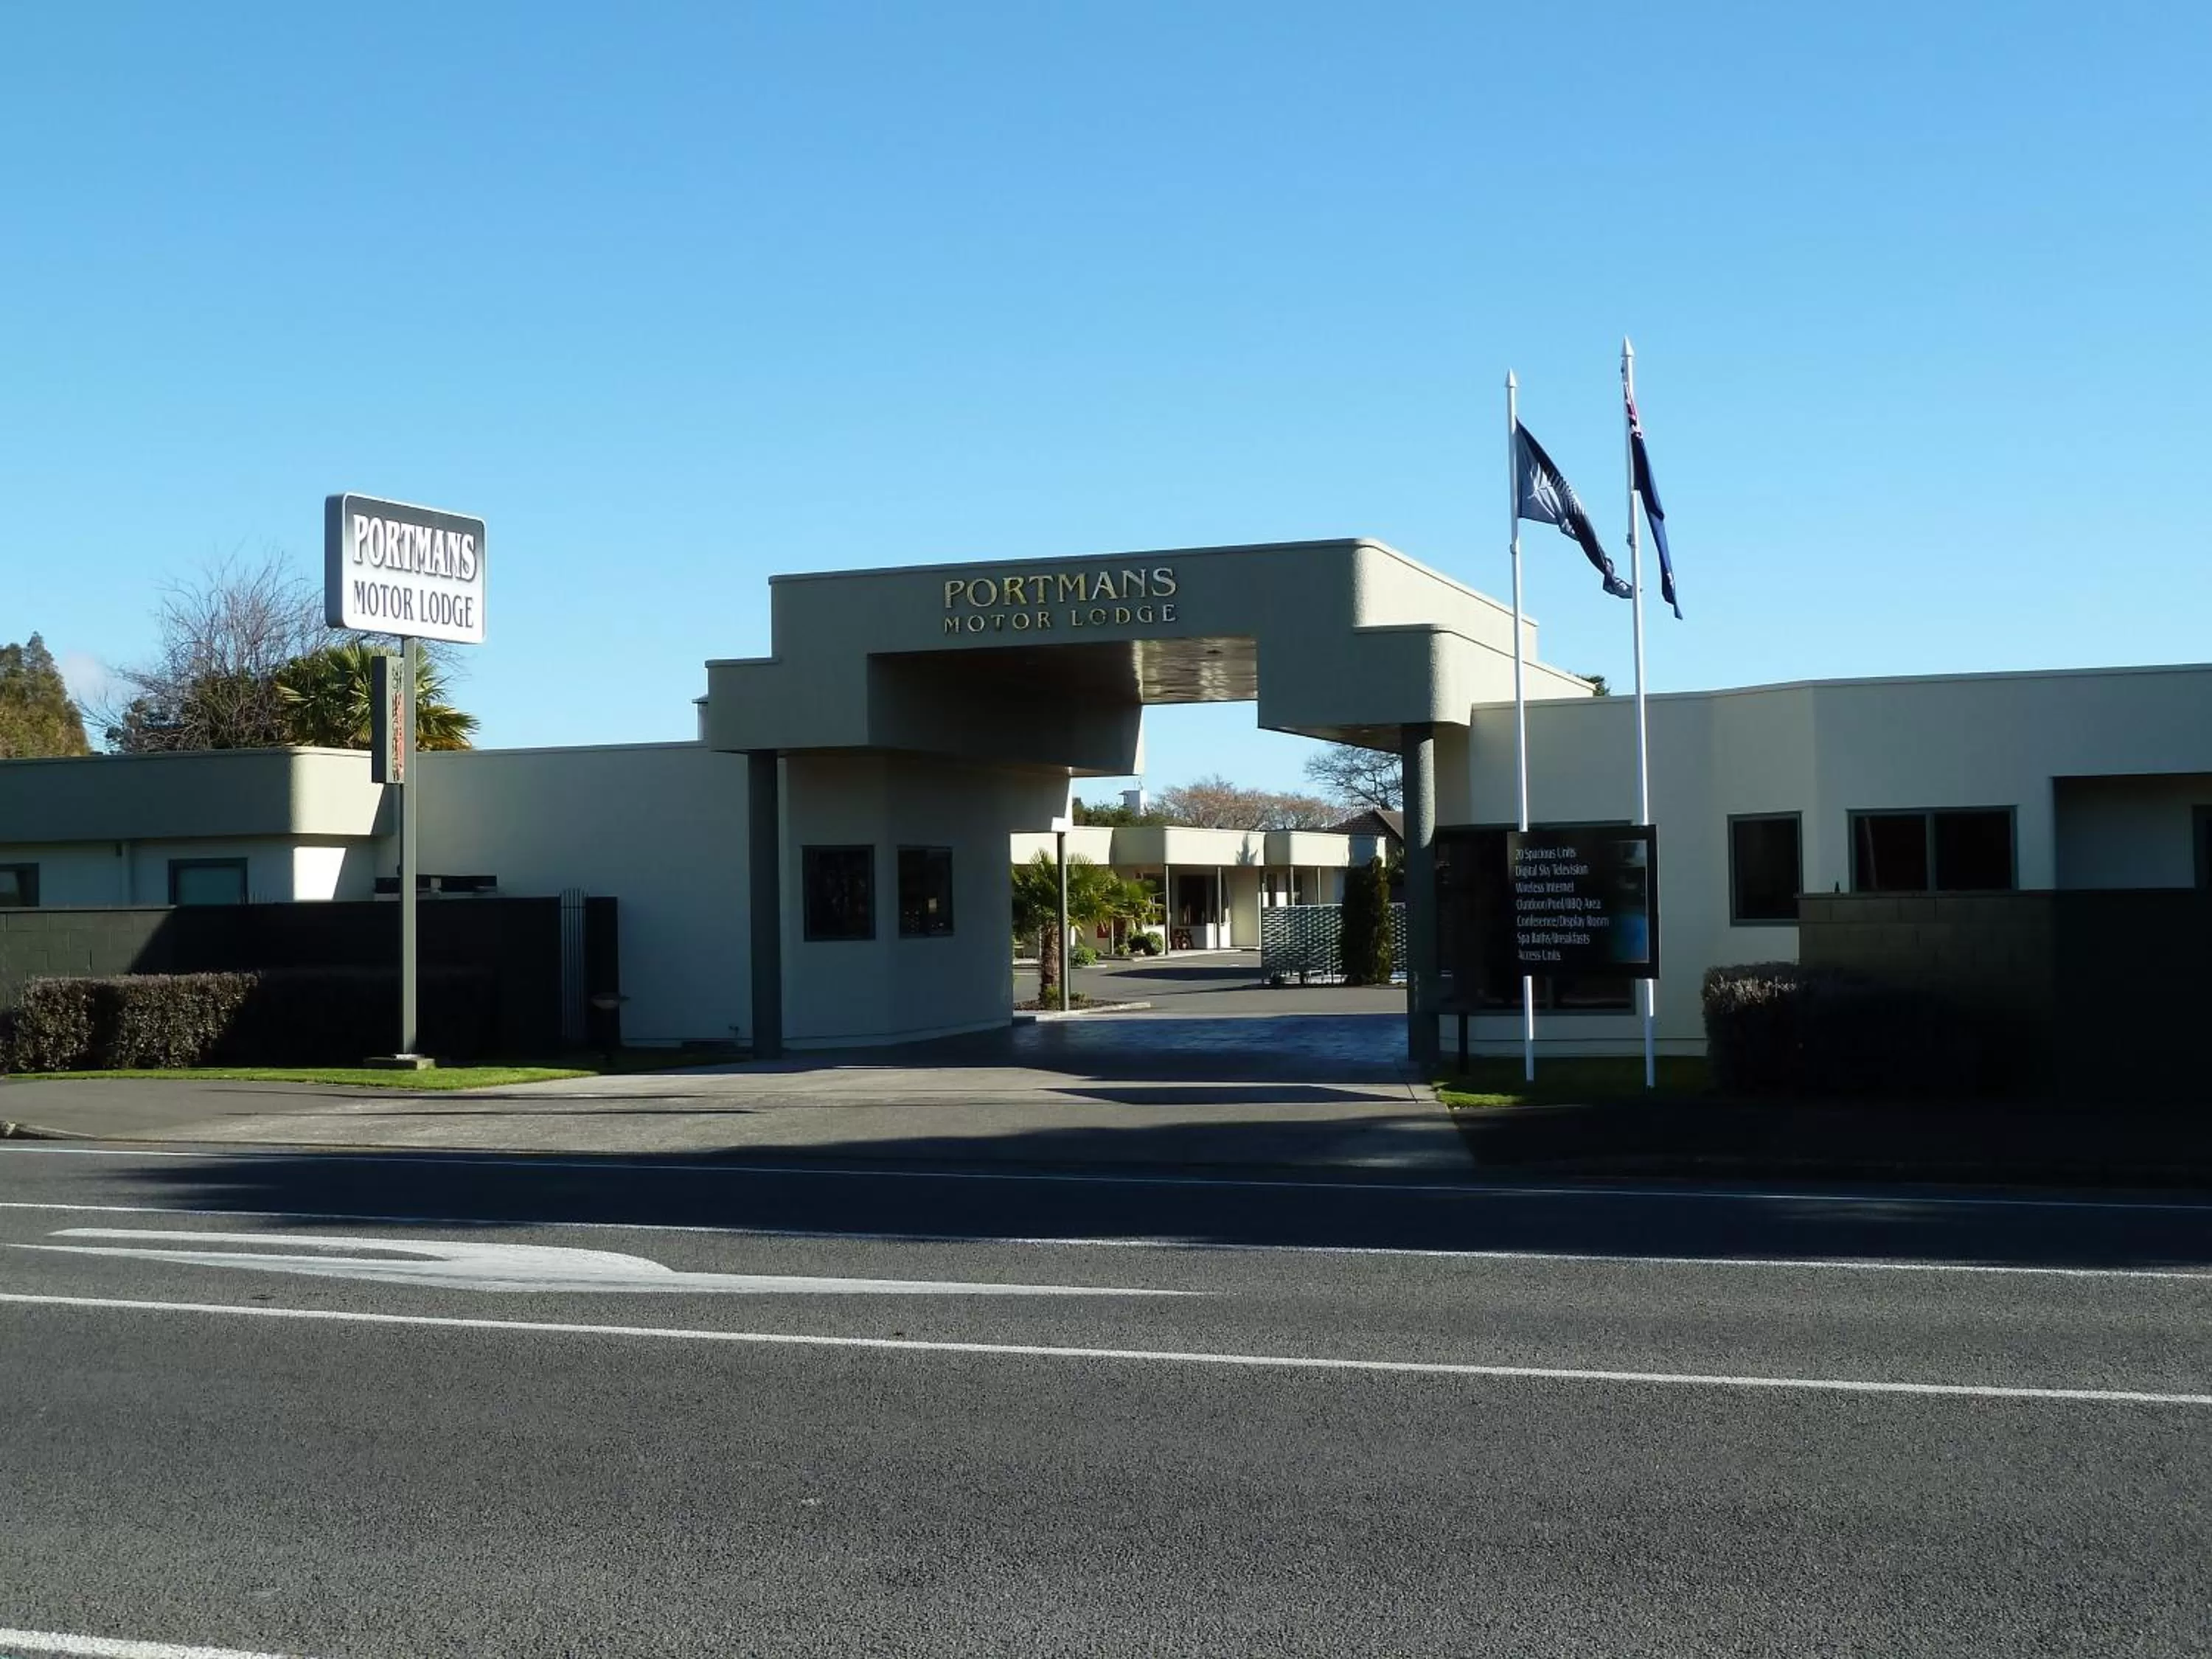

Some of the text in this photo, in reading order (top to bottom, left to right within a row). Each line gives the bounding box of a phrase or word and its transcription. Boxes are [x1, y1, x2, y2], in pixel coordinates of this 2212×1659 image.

[353, 514, 477, 582] PORTMANS
[944, 567, 1178, 608] PORTMANS
[354, 580, 474, 628] MOTOR LODGE
[944, 604, 1177, 634] MOTOR LODGE
[1515, 863, 1589, 878] Digital Sky Television
[1515, 881, 1574, 894] Wireless Internet
[1584, 897, 1601, 909] Area
[1586, 914, 1610, 927] Room
[1517, 931, 1530, 947] Spa
